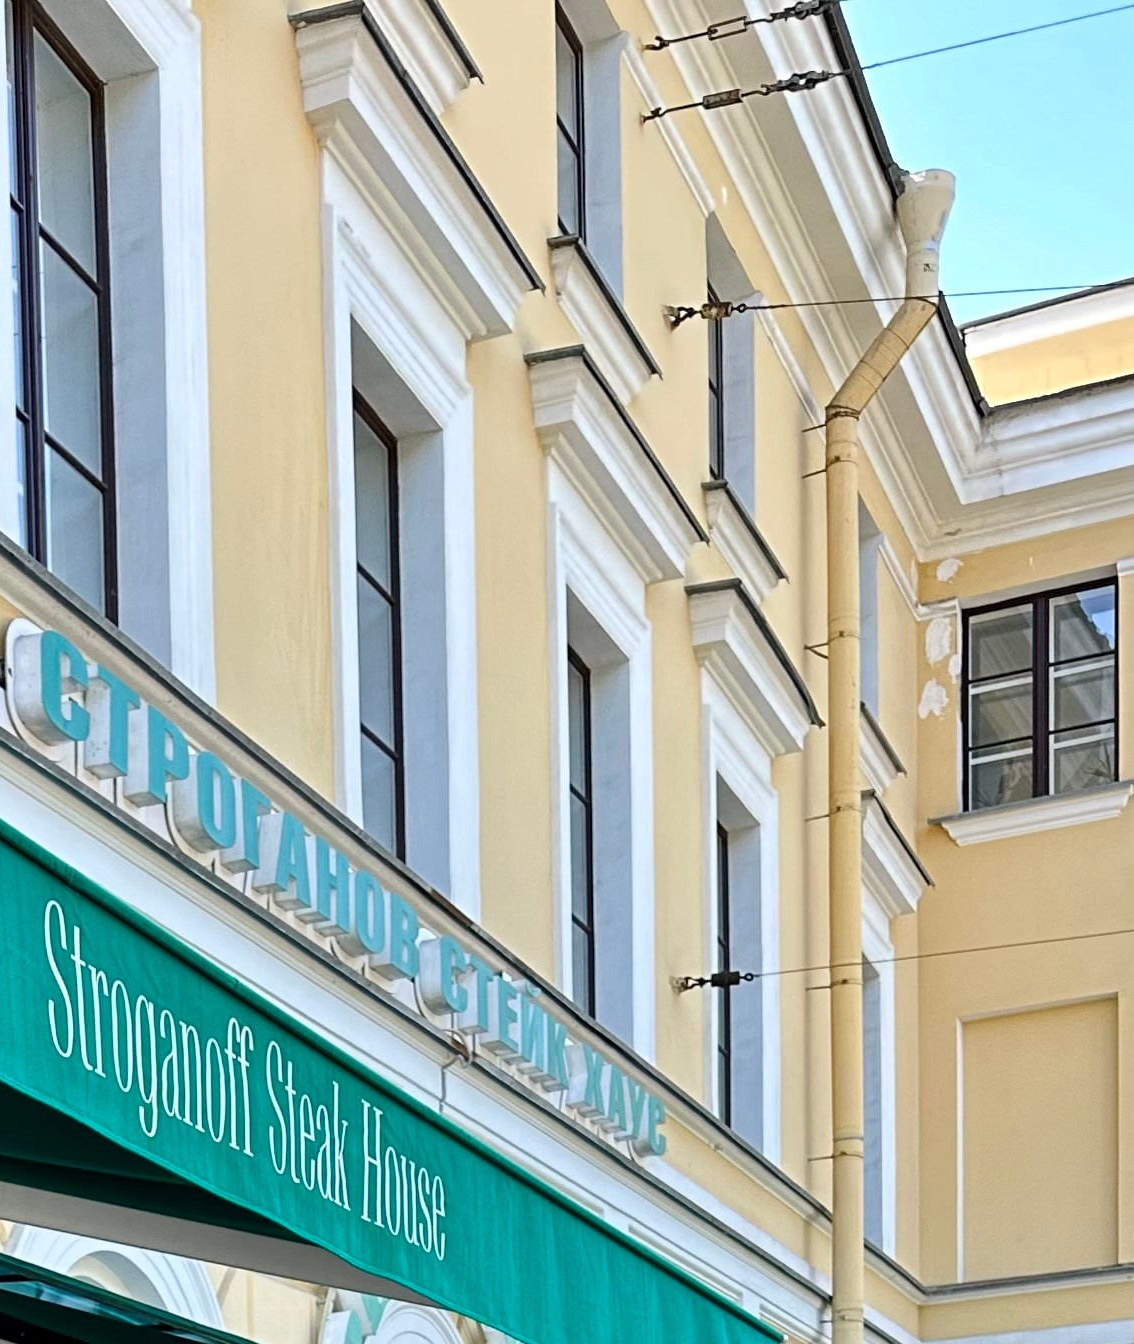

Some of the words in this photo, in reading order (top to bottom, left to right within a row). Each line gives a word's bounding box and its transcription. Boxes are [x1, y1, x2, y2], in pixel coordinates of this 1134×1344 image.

[40, 629, 420, 981] СТРОГАНОВ
[439, 934, 568, 1091] СТЕЙК
[582, 1042, 667, 1157] ХАУС
[44, 899, 255, 1158] Stroganoff
[265, 1040, 351, 1212] Steak
[360, 1098, 447, 1262] House
